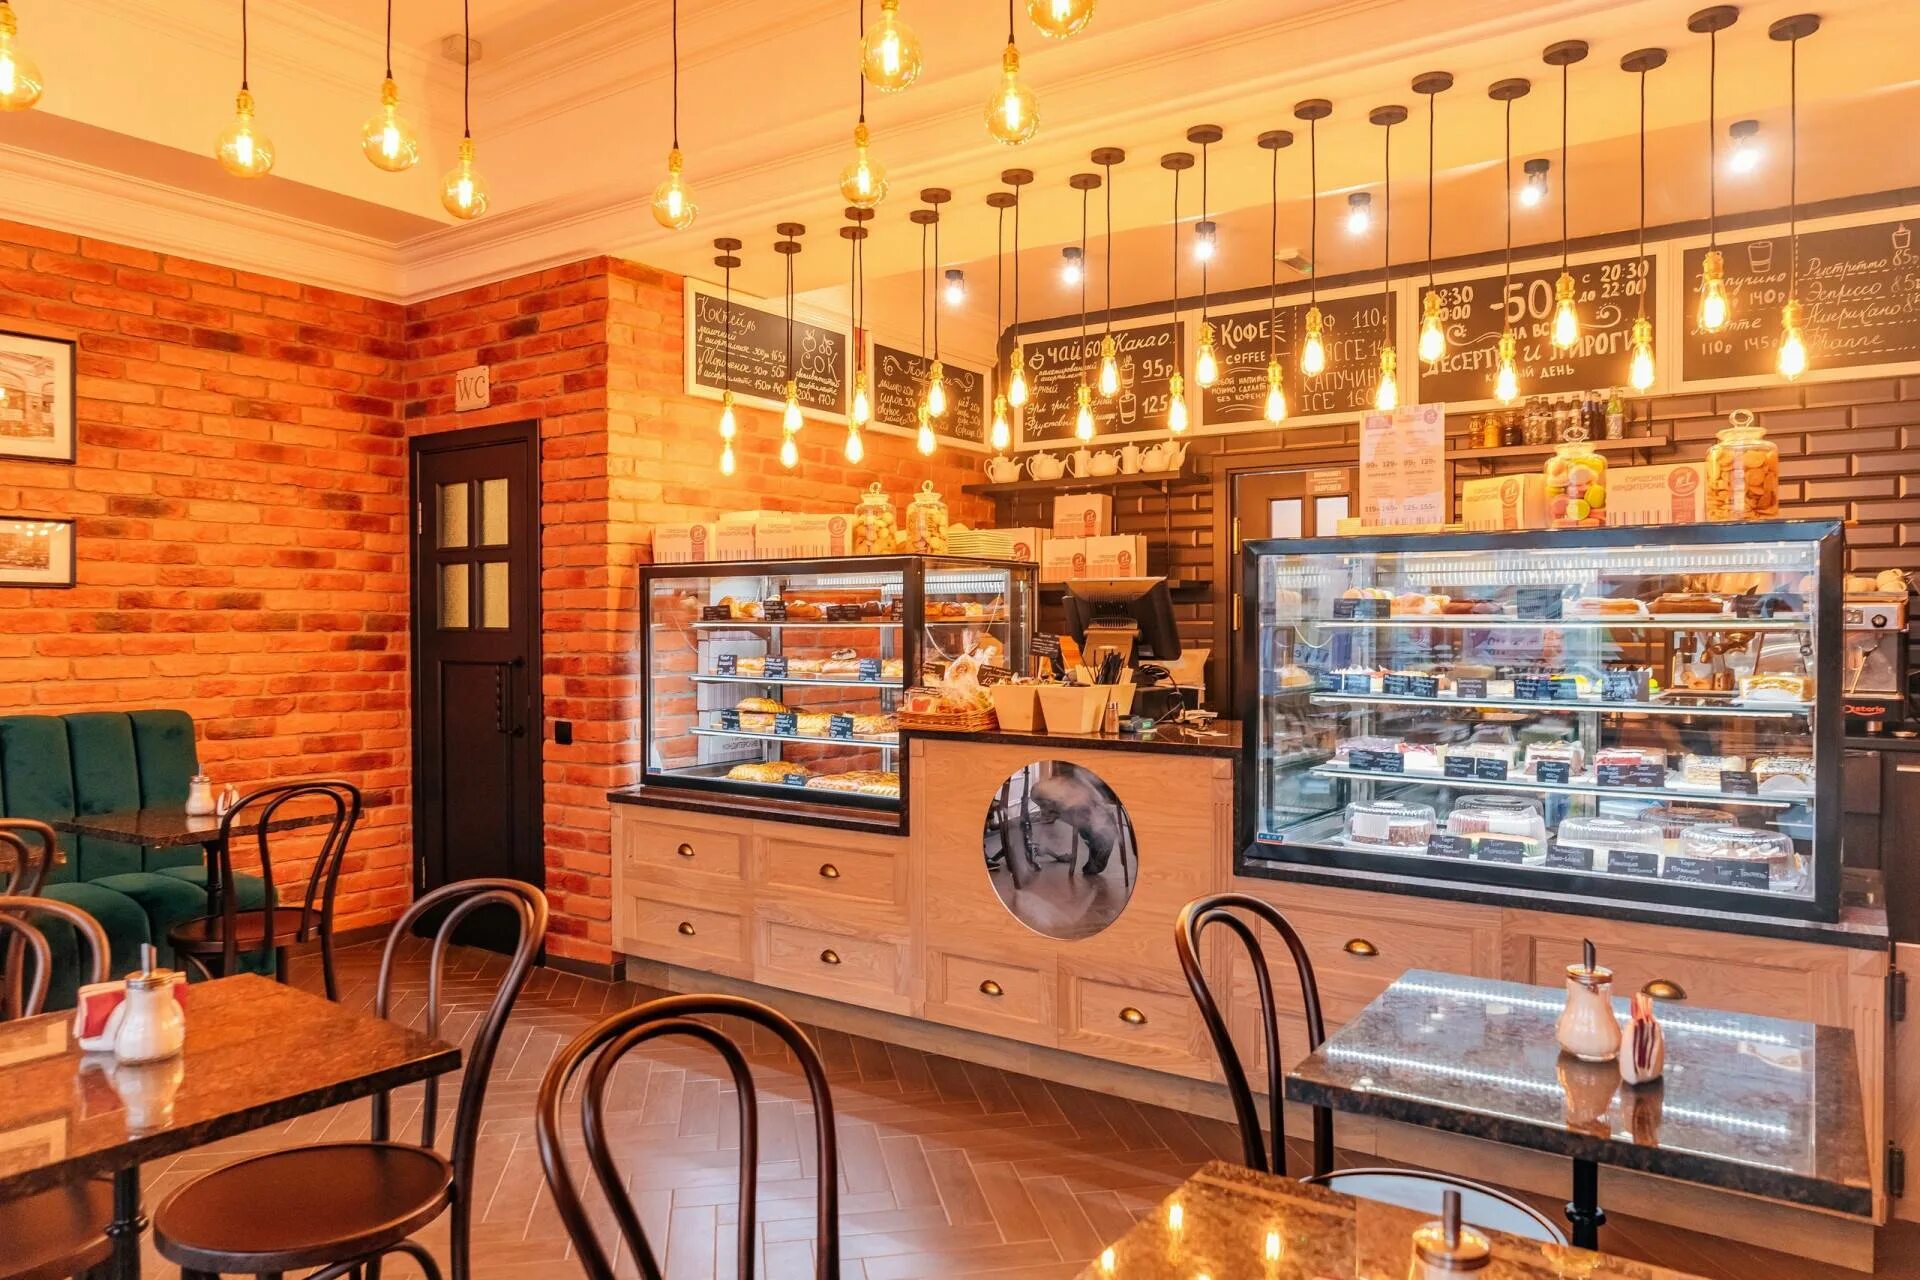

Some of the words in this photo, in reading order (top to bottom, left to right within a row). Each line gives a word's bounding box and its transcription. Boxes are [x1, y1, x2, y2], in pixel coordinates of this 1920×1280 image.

[1600, 260, 1650, 282] 20:30
[457, 375, 487, 401] WC
[1303, 368, 1380, 393] КАПУЧИН
